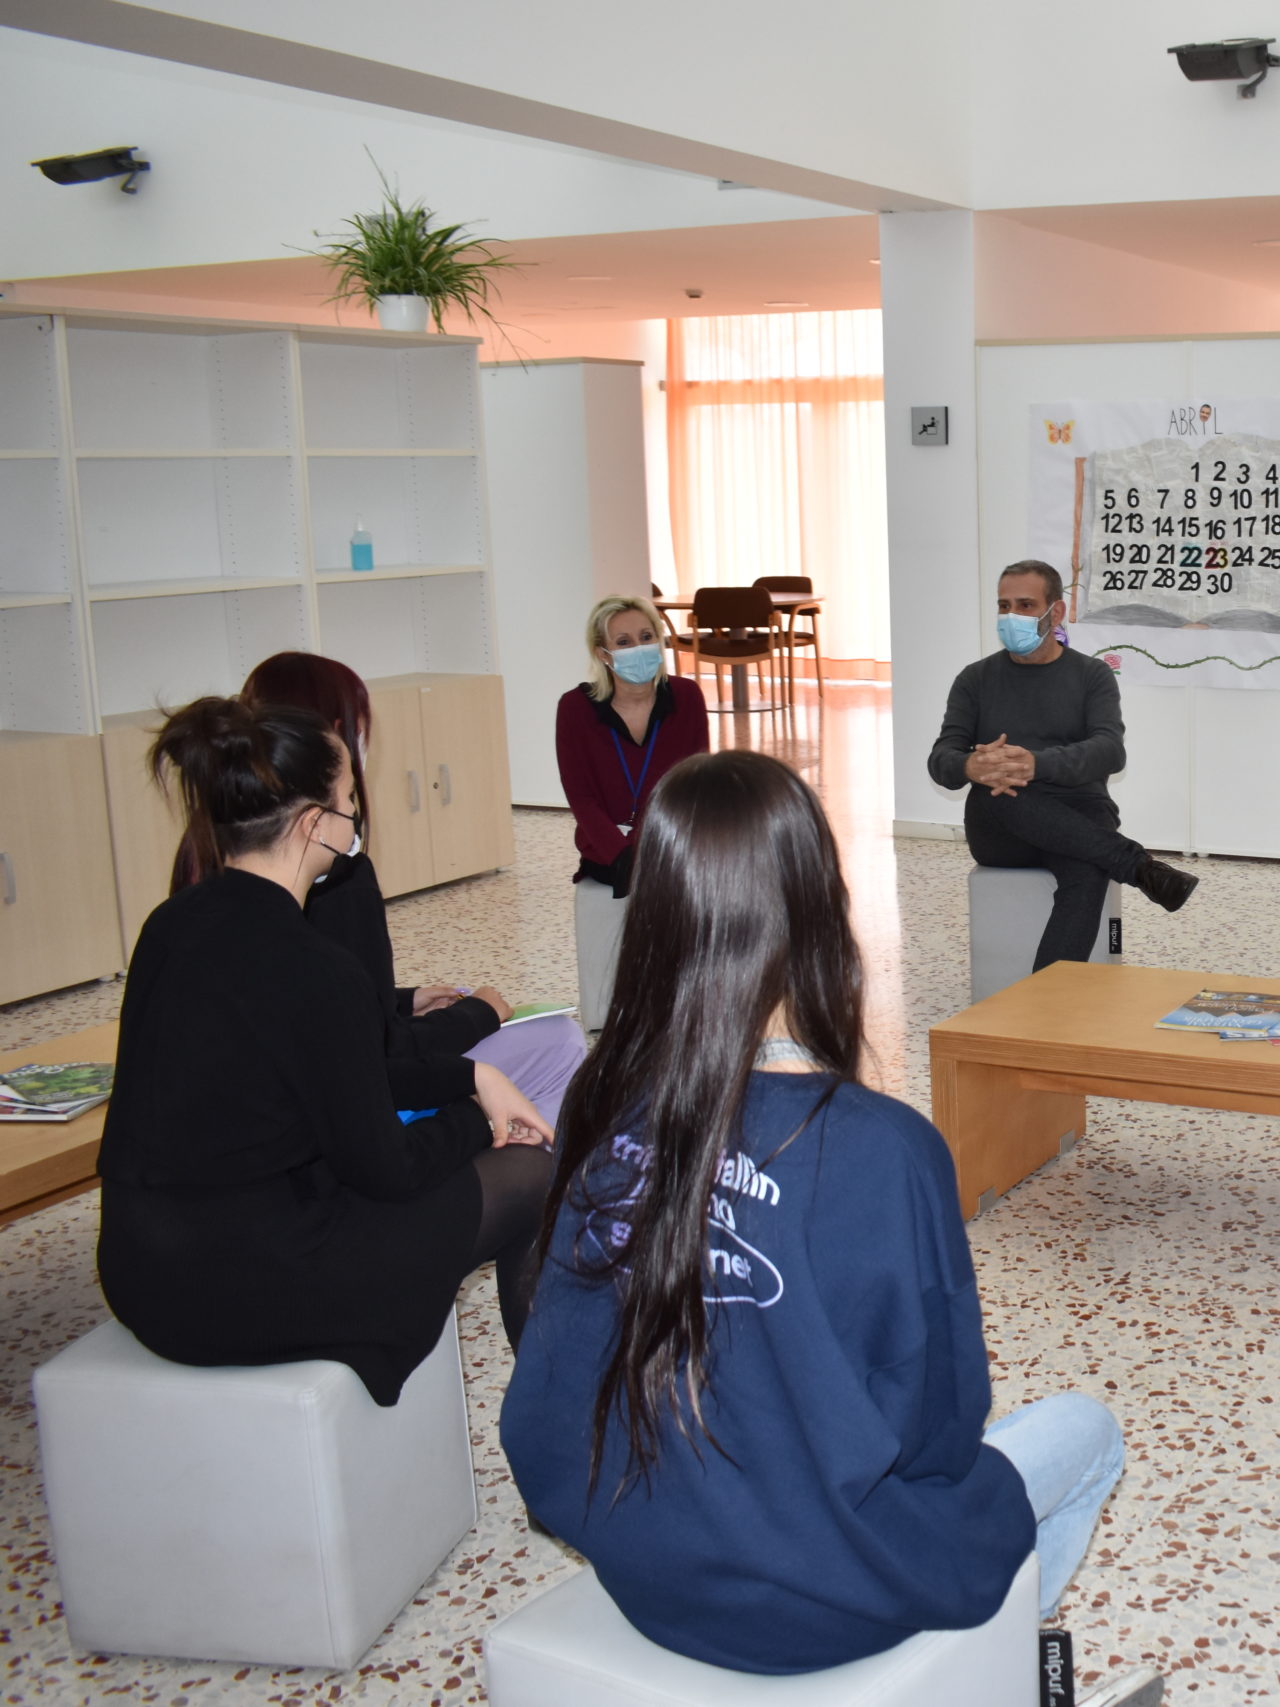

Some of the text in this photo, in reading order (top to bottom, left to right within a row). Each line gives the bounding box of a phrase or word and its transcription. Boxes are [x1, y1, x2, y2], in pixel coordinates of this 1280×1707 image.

[1190, 460, 1279, 485] 1 2 3 4
[1103, 486, 1279, 510] 5 6 7 8 9 10 11
[1100, 512, 1123, 534] 12
[1124, 512, 1145, 534] 13
[1152, 516, 1175, 537] 14
[1177, 516, 1201, 538] 15
[1204, 519, 1227, 541] 16
[1232, 516, 1257, 538] 17
[1101, 542, 1125, 564] 19
[1128, 543, 1151, 565] 20
[1156, 543, 1175, 565] 21
[1179, 546, 1203, 568] 22
[1204, 546, 1229, 570] 23
[1231, 545, 1255, 568] 24
[1102, 567, 1233, 595] 26 27 28 29 30
